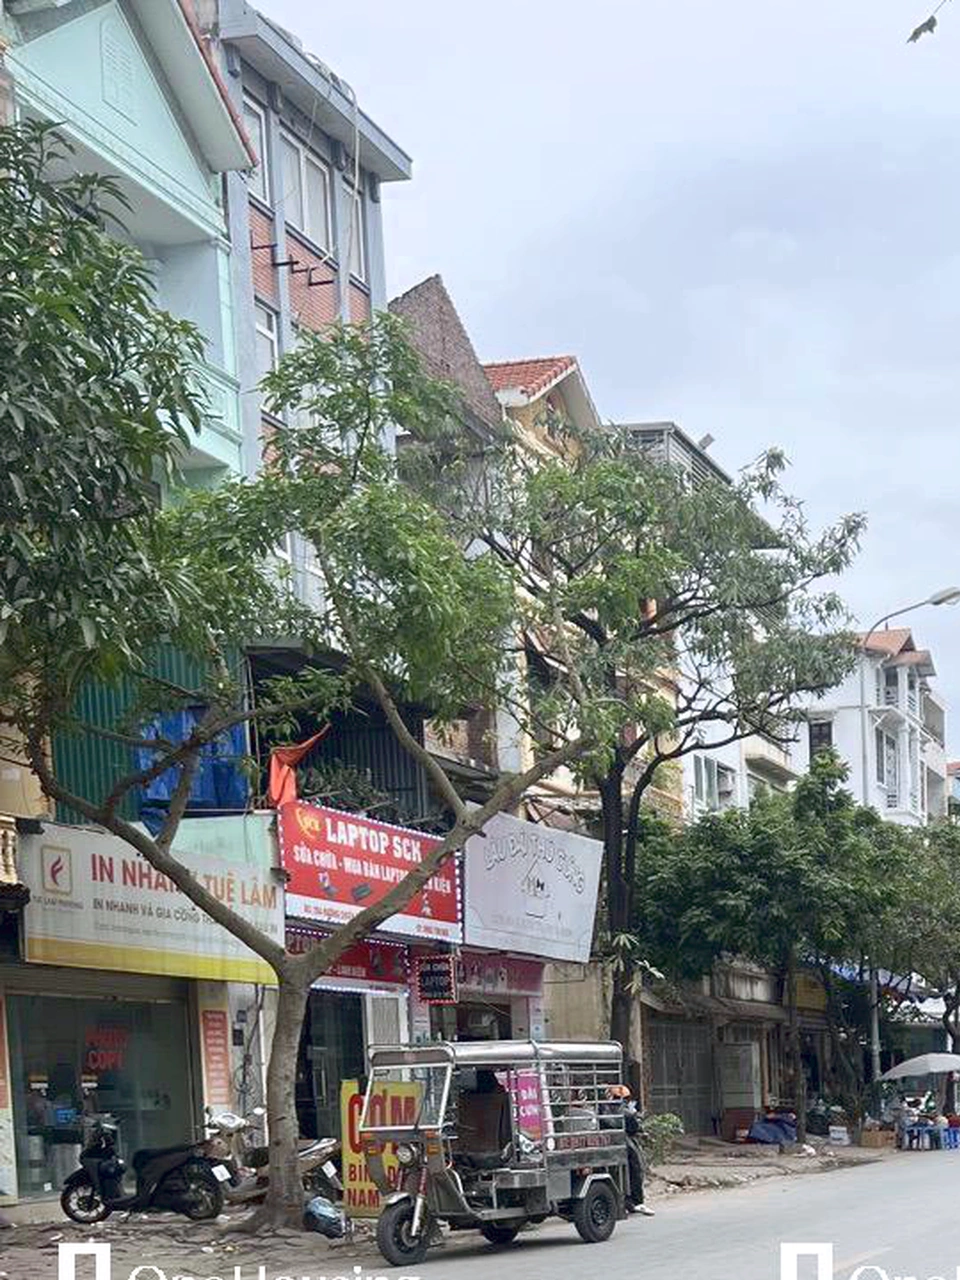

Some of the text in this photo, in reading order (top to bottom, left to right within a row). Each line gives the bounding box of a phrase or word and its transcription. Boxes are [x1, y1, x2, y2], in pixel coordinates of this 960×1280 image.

[325, 817, 422, 863] LAPTOP SCK
[91, 853, 114, 883] IN
[241, 872, 277, 910] LÂM
[347, 1187, 380, 1208] NAM
